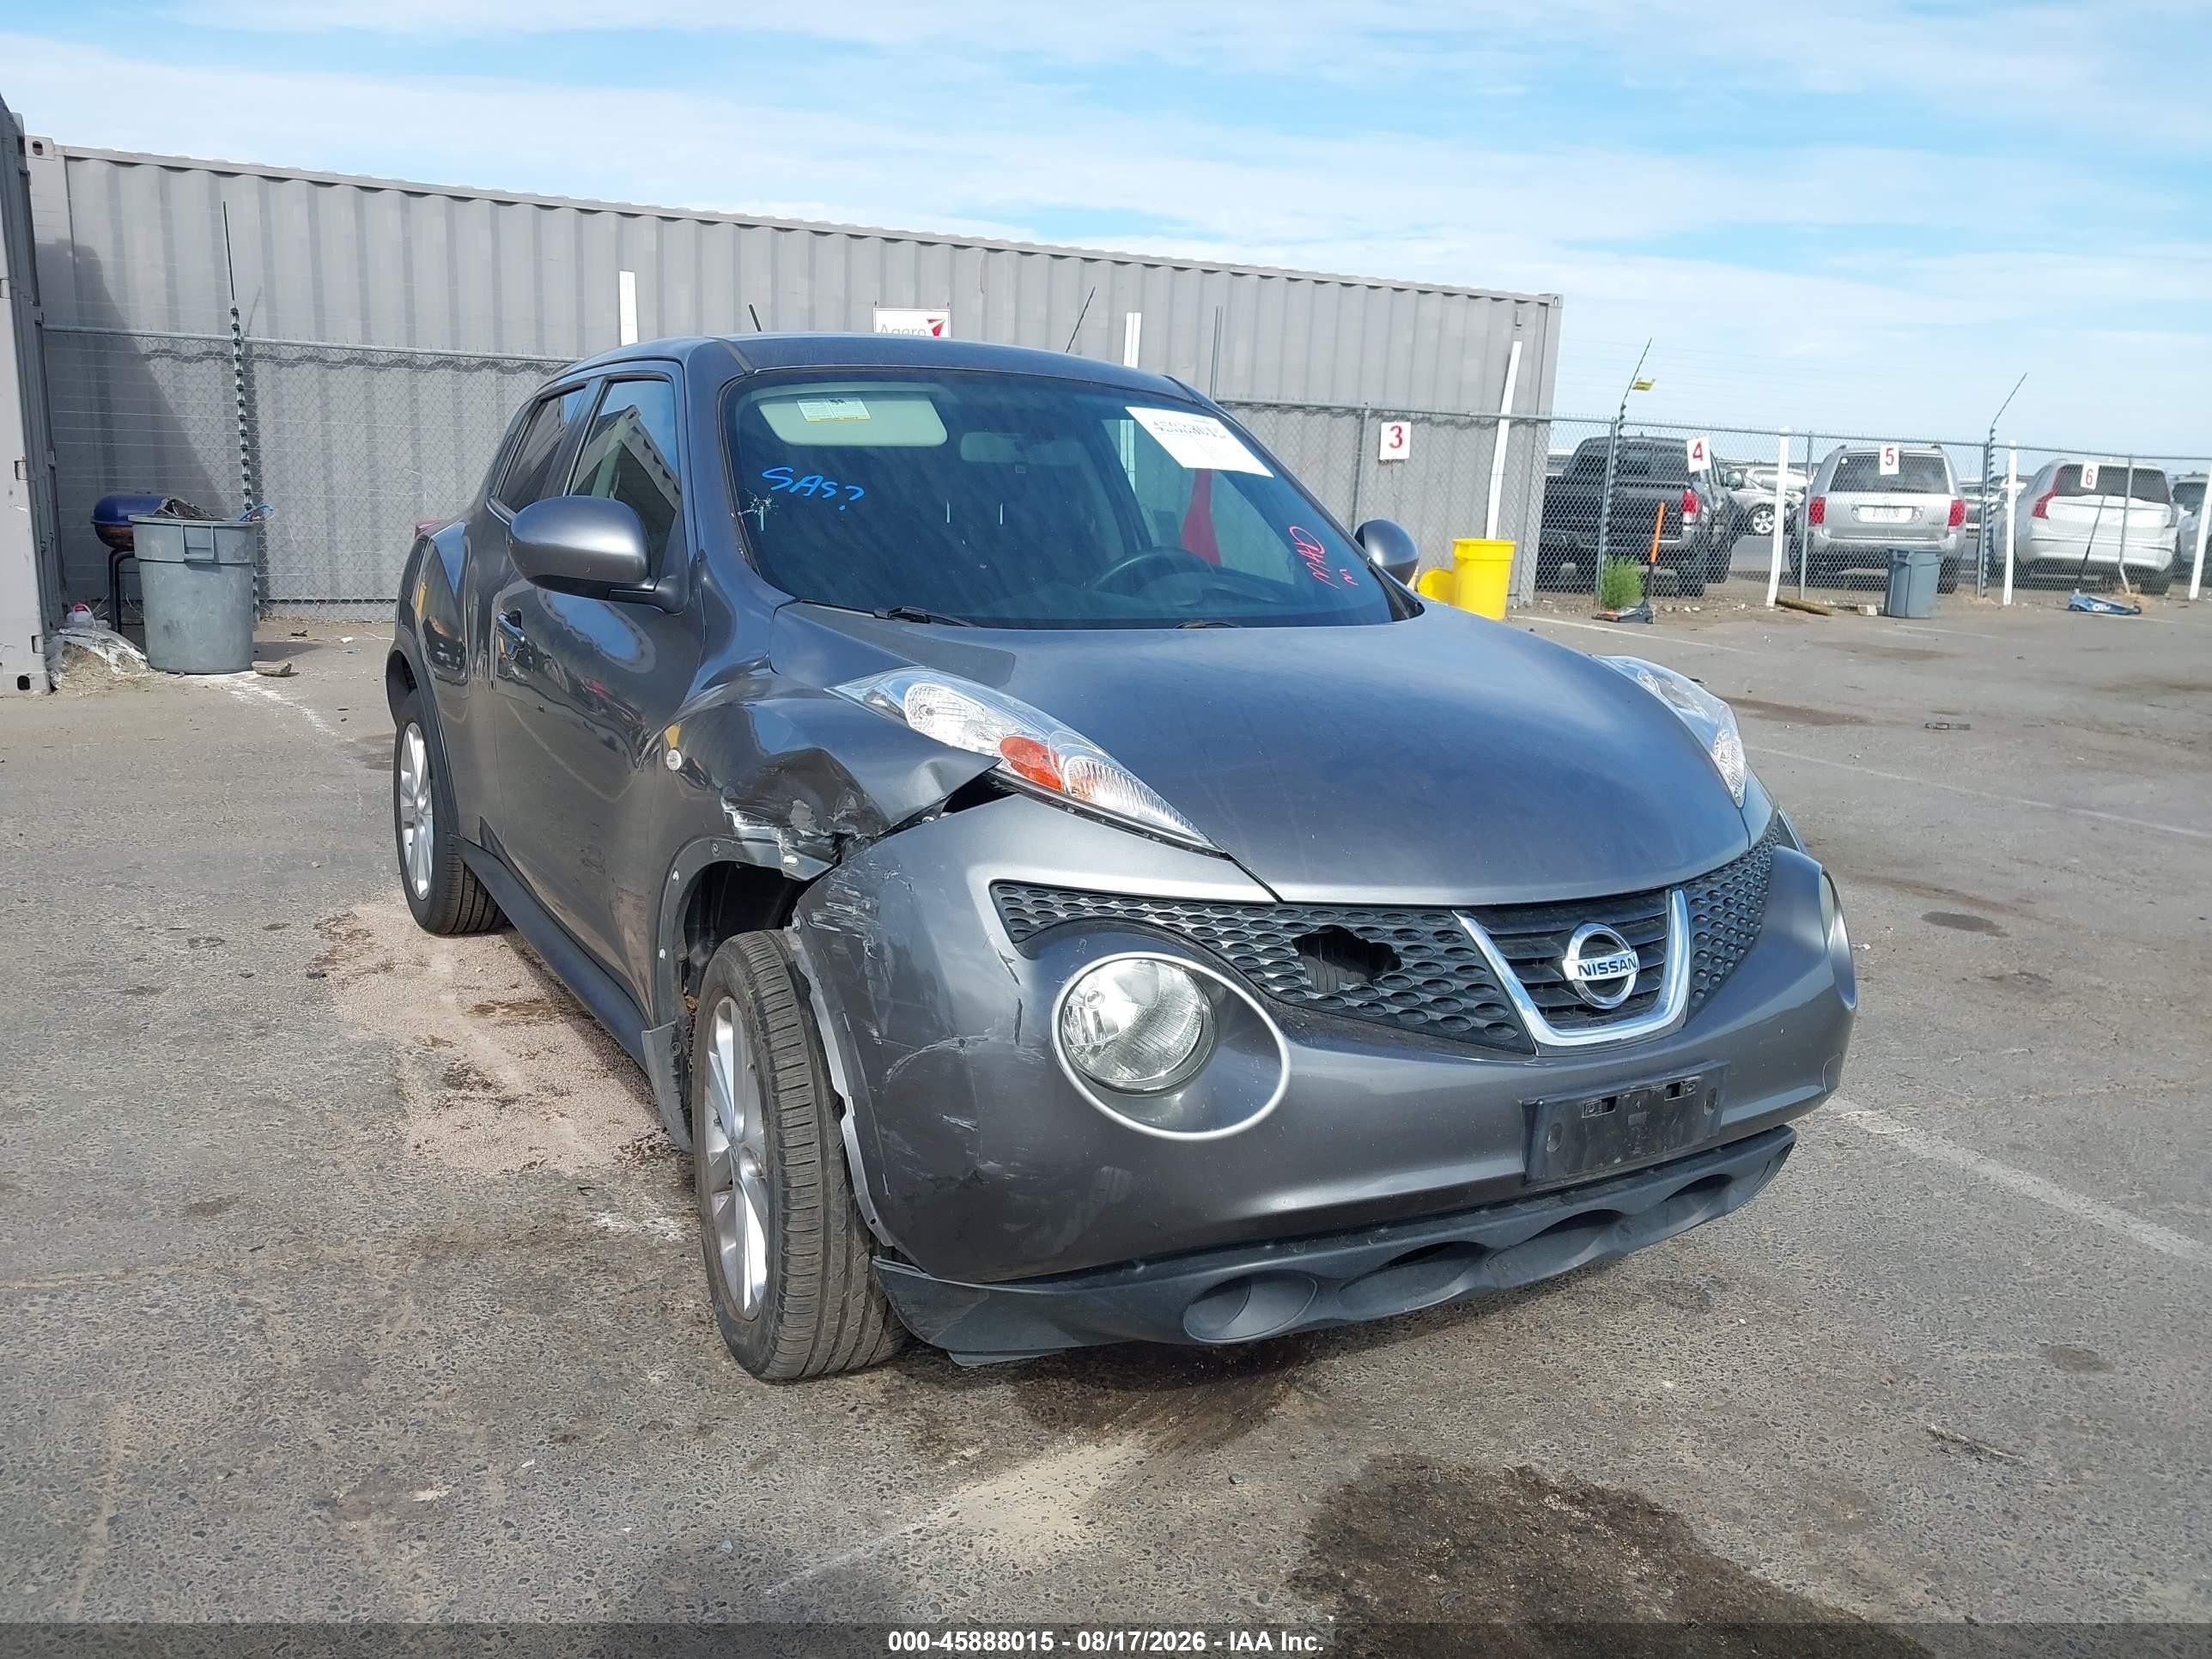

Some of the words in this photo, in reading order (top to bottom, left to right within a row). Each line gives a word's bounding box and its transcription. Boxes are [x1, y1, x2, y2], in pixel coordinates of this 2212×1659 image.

[1389, 424, 1404, 448] 3
[1692, 441, 1705, 461] 4
[1884, 447, 1895, 466] 5
[2085, 468, 2094, 485] 6
[1577, 955, 1638, 977] NISSAN
